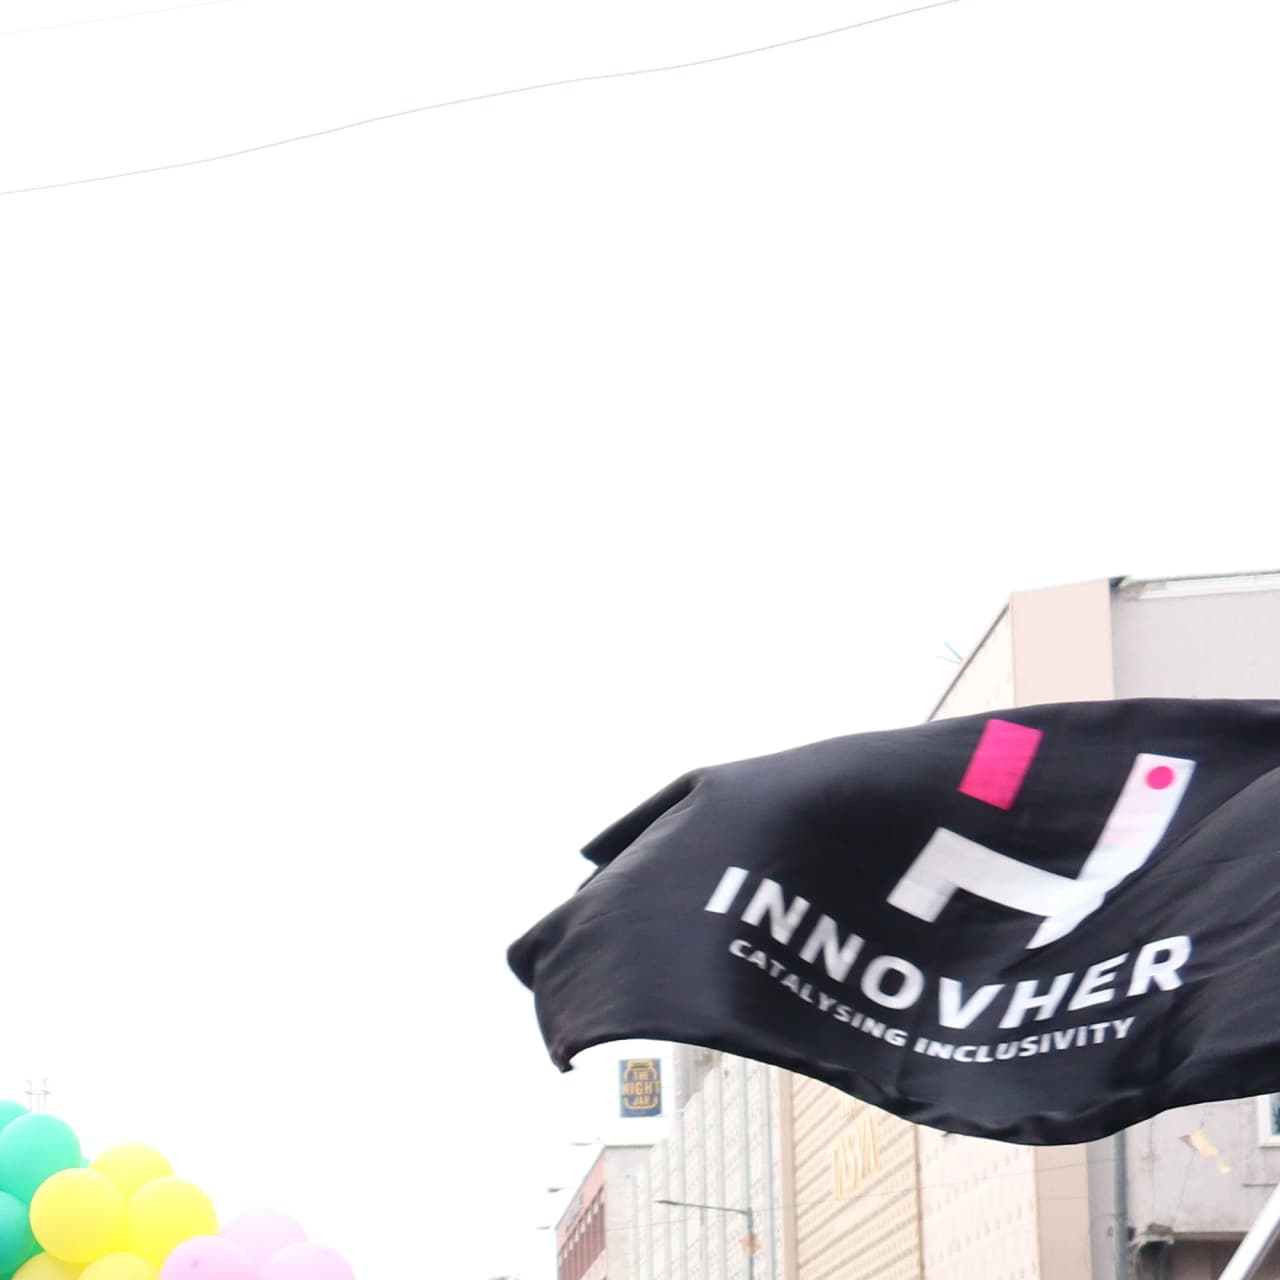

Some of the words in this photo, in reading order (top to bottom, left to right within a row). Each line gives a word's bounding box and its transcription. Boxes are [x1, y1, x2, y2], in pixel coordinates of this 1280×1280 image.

[704, 866, 1192, 1030] INNOVHER
[729, 937, 908, 1047] CATALYSING
[912, 1016, 1137, 1063] INCLUSIVITY
